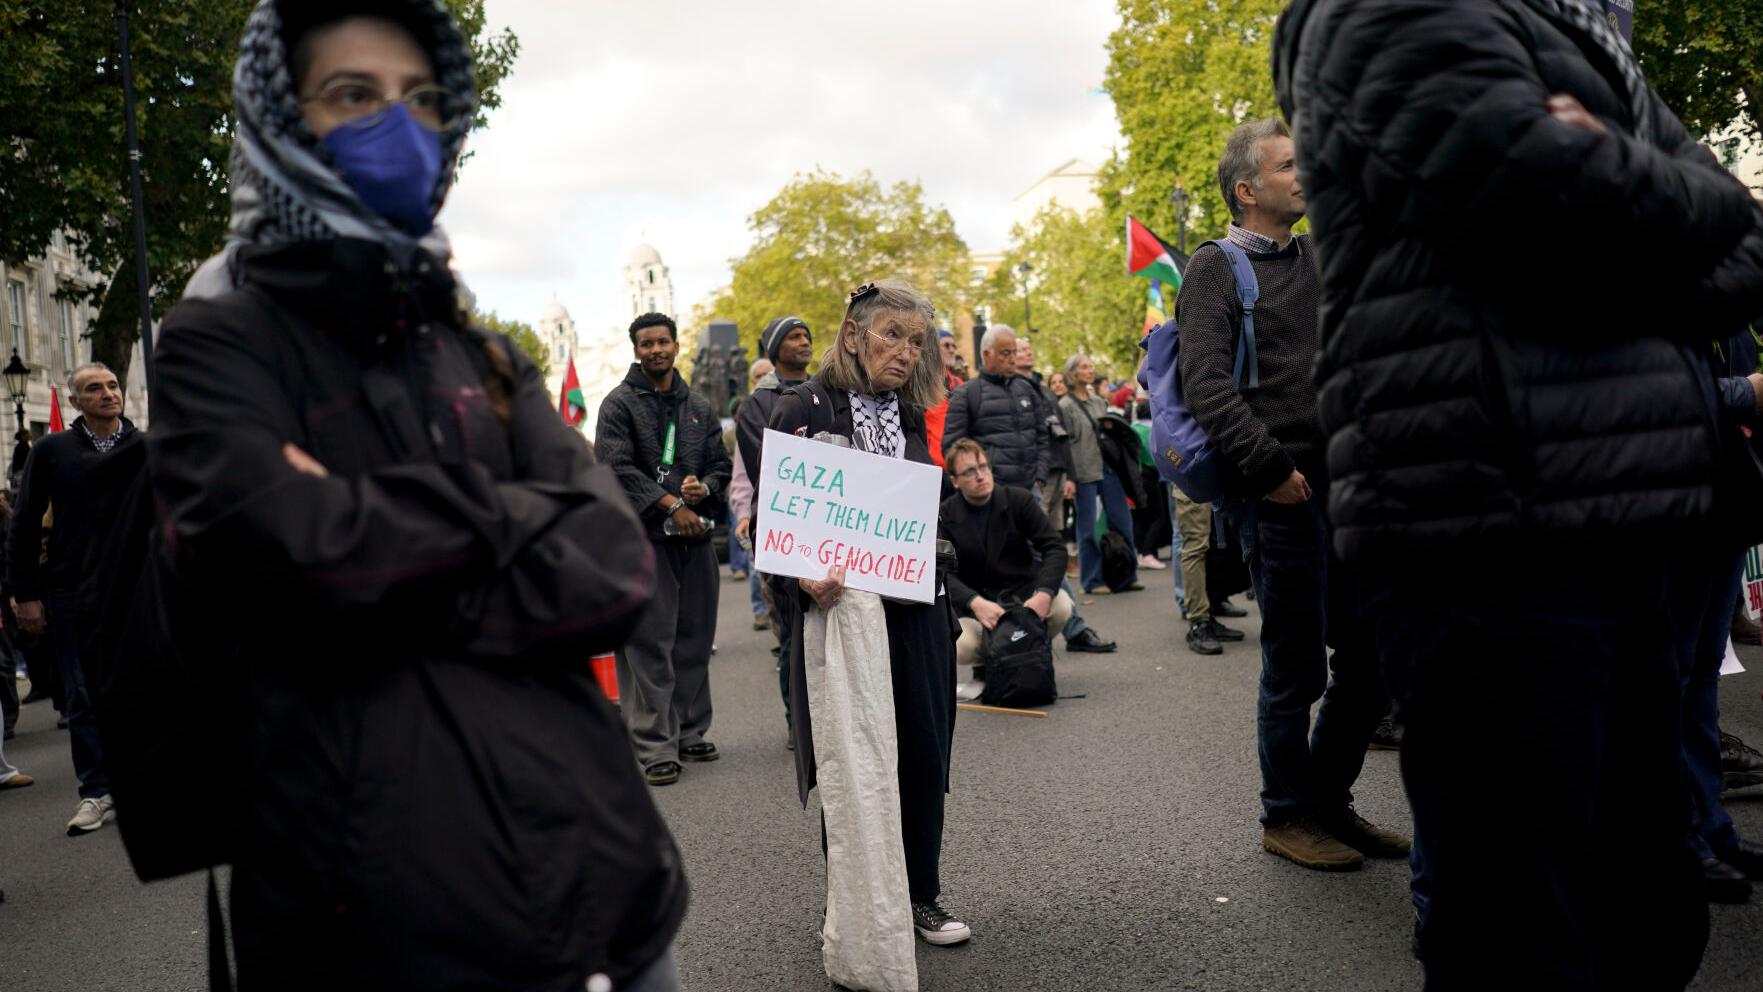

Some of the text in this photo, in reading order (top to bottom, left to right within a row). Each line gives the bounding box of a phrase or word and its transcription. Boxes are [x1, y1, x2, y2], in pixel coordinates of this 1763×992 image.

[777, 456, 845, 497] GAZA
[769, 490, 927, 544] LET THEM LIVE!
[764, 528, 795, 556] NO
[817, 539, 927, 584] GENOCIDE!
